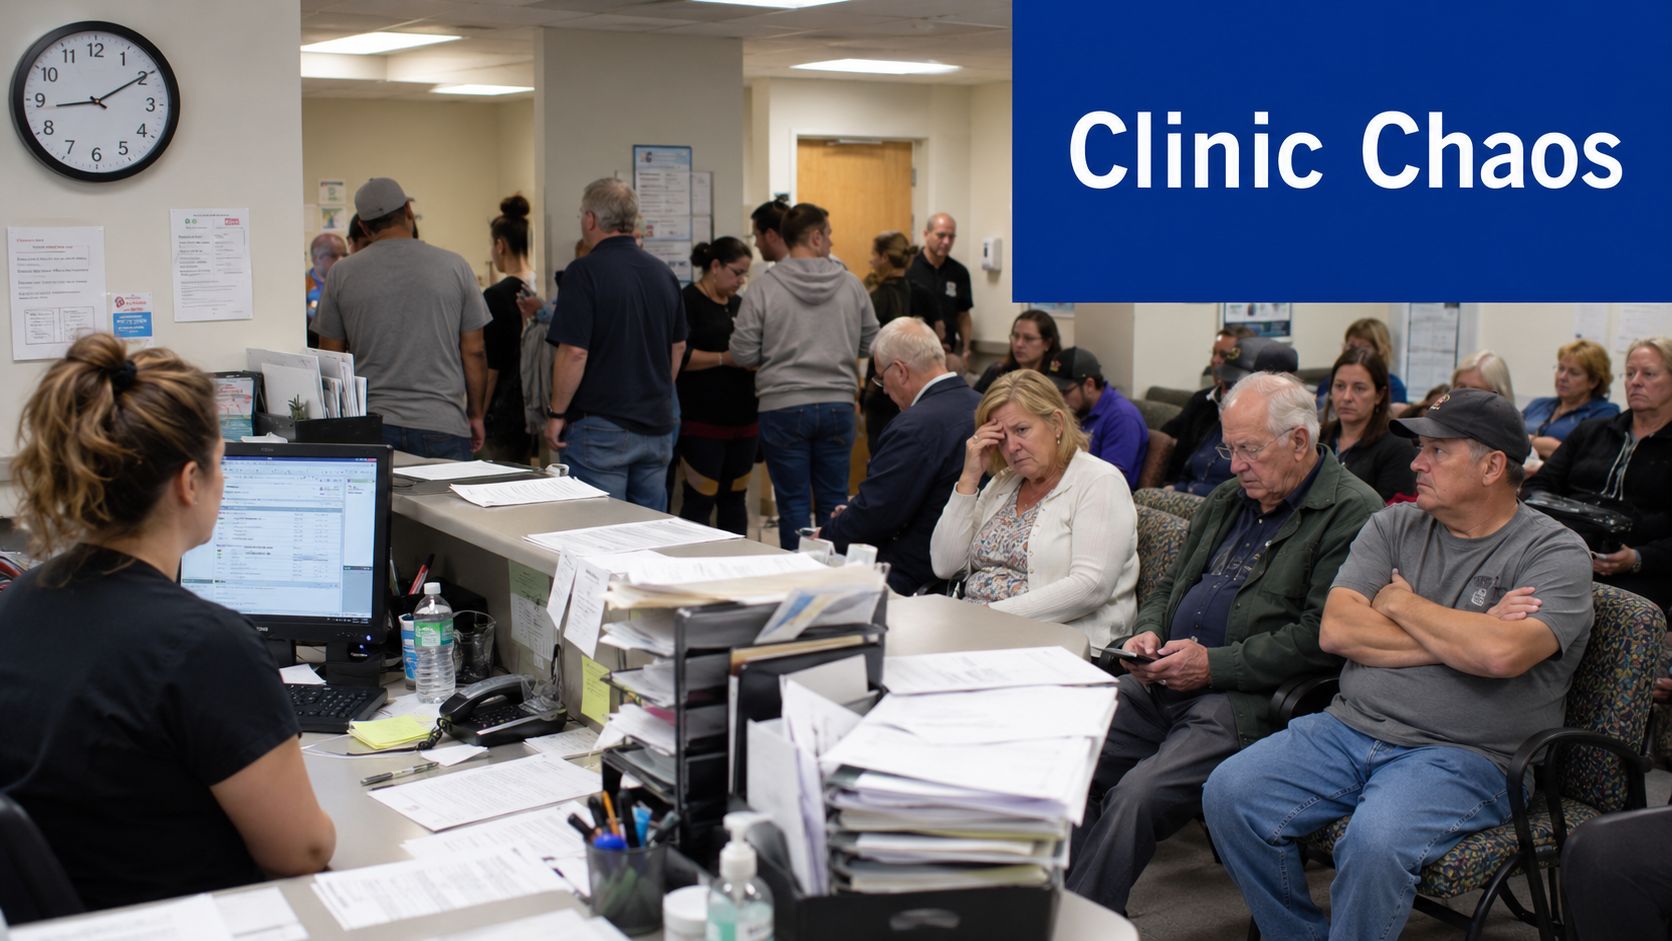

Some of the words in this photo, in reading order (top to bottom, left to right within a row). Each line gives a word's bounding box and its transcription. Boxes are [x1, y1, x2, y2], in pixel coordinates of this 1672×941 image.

[62, 49, 76, 64] 11
[87, 43, 104, 58] 12
[119, 52, 126, 66] 1
[41, 67, 58, 82] 10
[137, 71, 148, 85] 2
[35, 93, 46, 108] 9
[145, 97, 156, 112] 3
[43, 120, 54, 135] 8
[136, 123, 148, 138] 4
[65, 140, 75, 154] 7
[91, 147, 102, 162] 6
[118, 141, 129, 155] 5
